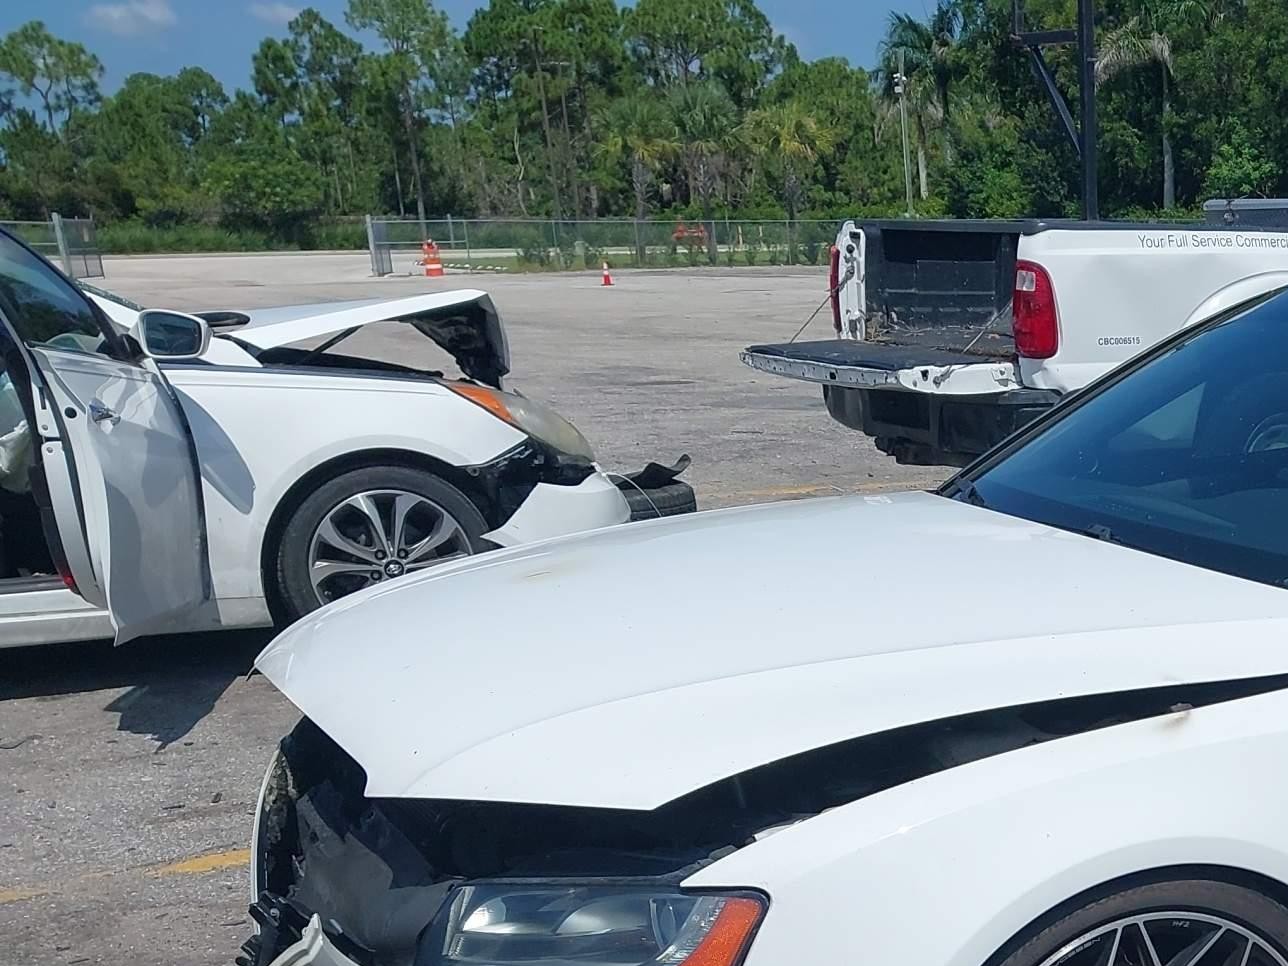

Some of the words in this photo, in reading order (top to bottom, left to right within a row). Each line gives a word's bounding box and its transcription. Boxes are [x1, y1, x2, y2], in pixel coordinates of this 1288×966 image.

[1137, 234, 1164, 248] Your
[1168, 234, 1188, 248] Full
[1191, 234, 1233, 248] Service
[1097, 336, 1141, 346] CBC006515
